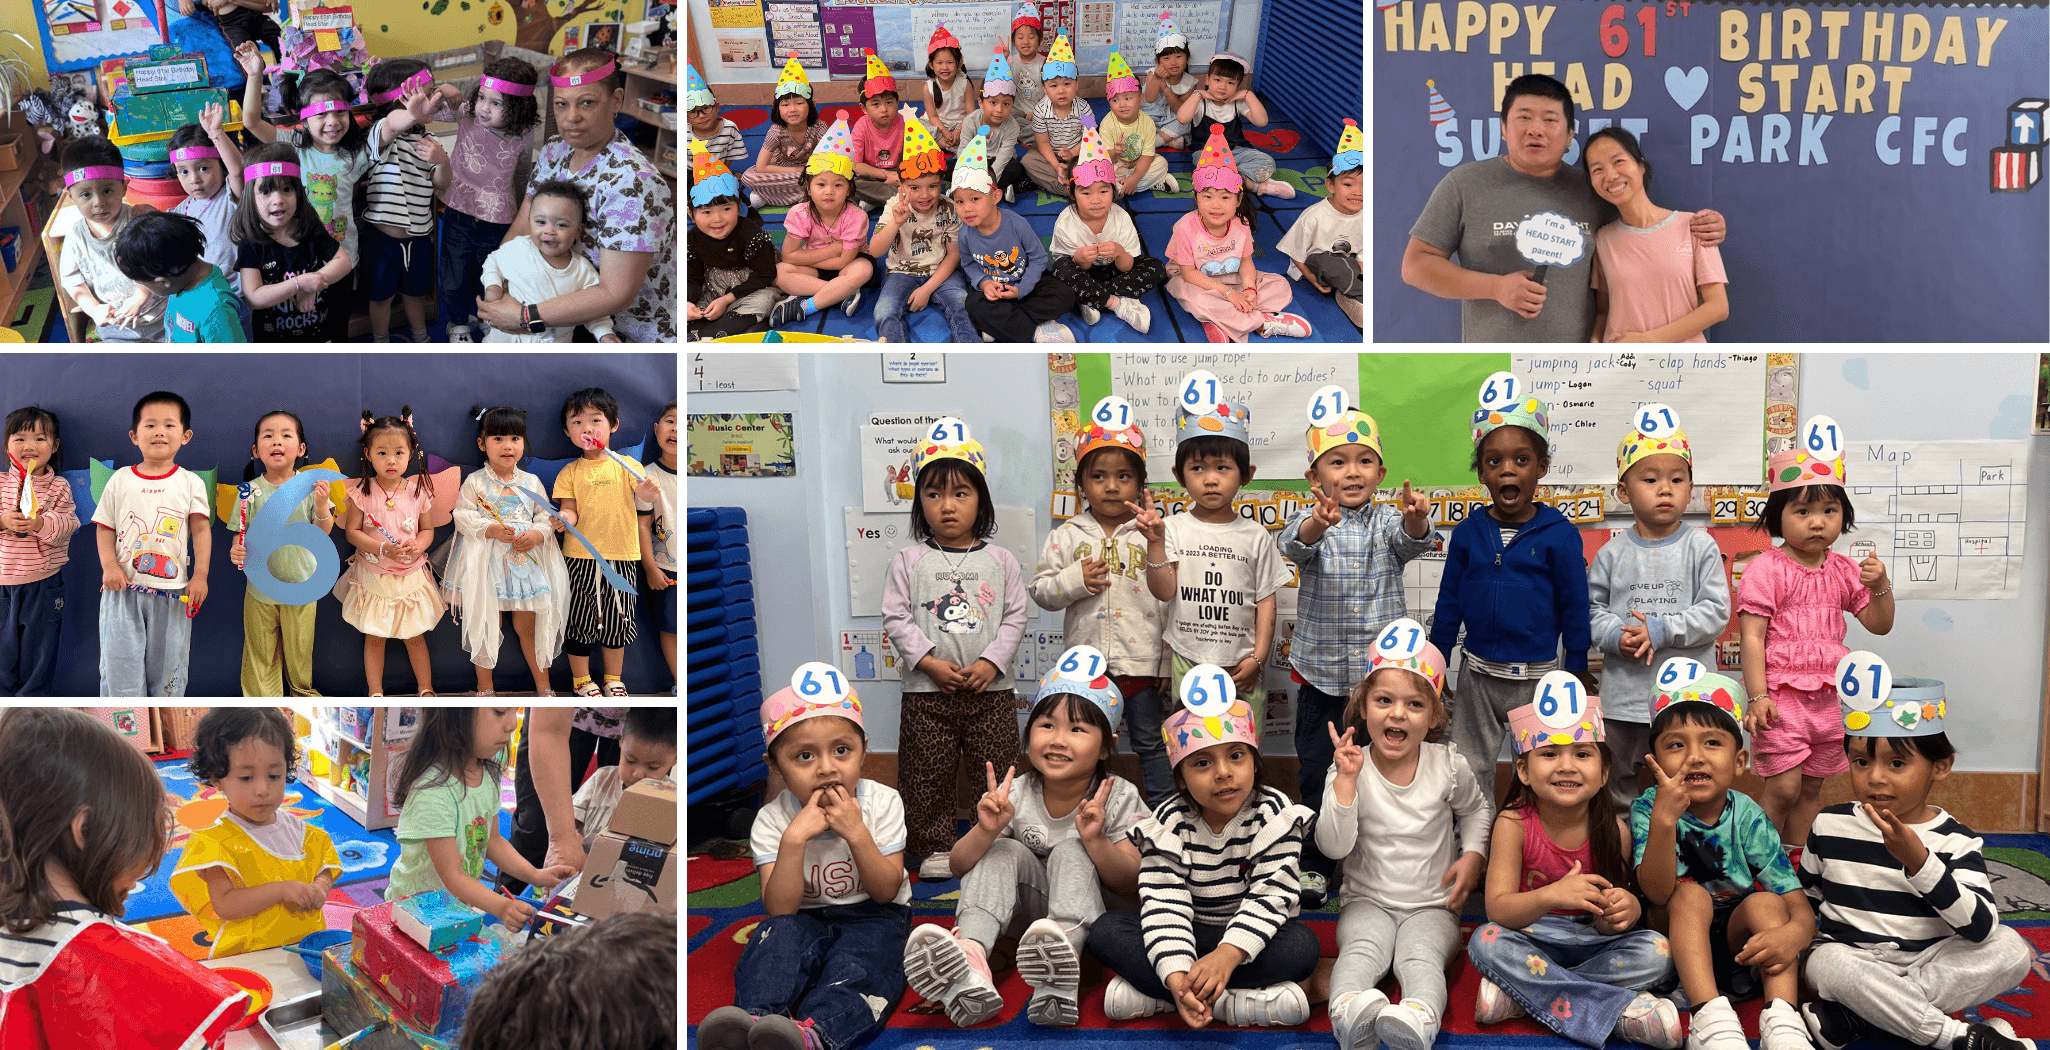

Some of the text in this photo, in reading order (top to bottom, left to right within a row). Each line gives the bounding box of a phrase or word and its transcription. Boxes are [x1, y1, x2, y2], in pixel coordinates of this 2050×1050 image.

[1383, 1, 1691, 58] HAPPY 61 ST
[1719, 8, 2009, 67] BIRTHDAY
[171, 66, 196, 74] Birthday
[1493, 61, 1912, 114] HAD START
[1690, 114, 1834, 166] PARK
[1875, 115, 1968, 167] CFC
[916, 153, 933, 171] 61
[953, 169, 968, 186] 61
[1205, 169, 1219, 182] 61
[1545, 219, 1558, 229] I'm
[1526, 229, 1549, 241] HEAD
[1551, 235, 1577, 248] START
[1532, 247, 1562, 260] parent!
[1125, 353, 1150, 364] How
[1155, 352, 1168, 364] to
[1171, 356, 1188, 364] use
[1192, 355, 1218, 367] jump
[1527, 354, 1615, 374] jumping jack
[1659, 353, 1727, 370] clap hands
[694, 366, 704, 378] 4
[1123, 367, 1336, 385] What do to our bodies?
[715, 380, 735, 389] least
[1183, 379, 1216, 405] 61
[1482, 378, 1514, 404] 61
[1529, 379, 1592, 394] jump Logan
[1647, 378, 1683, 391] squat
[1127, 392, 1171, 407] How to
[1311, 391, 1342, 420] 61
[1563, 400, 1595, 408] Osmarie
[871, 417, 912, 425] Question
[914, 416, 923, 424] of
[925, 416, 939, 424] the
[1096, 402, 1129, 425] 61
[1155, 415, 1168, 428] to
[1640, 408, 1674, 433] 61
[931, 423, 964, 441] 61
[1575, 420, 1596, 428] Chloe
[1153, 433, 1276, 448] to ame?
[1808, 424, 1838, 451] 61
[888, 446, 900, 454] ask
[1867, 444, 1912, 466] Map
[1981, 469, 2005, 481] Park
[1062, 496, 1067, 516] 1
[1172, 501, 1186, 517] 6
[1240, 503, 1254, 520] 9
[1449, 501, 1464, 521] 18
[1560, 501, 1577, 518] 23
[1578, 498, 1600, 517] 24
[1714, 500, 1737, 518] 29
[1745, 500, 1766, 518] 30
[1258, 506, 1277, 527] 10
[857, 528, 881, 539] Yes
[1199, 544, 1232, 556] LOADING
[1208, 552, 1236, 560] BETTER
[1237, 555, 1248, 564] LIFE
[936, 571, 979, 581] KUOMI
[1205, 570, 1222, 587] DO
[1181, 586, 1243, 606] WHAT YOU
[1199, 605, 1229, 621] LOVE
[843, 633, 849, 645] 1
[882, 632, 889, 643] 2
[1038, 632, 1046, 644] 6
[1380, 626, 1420, 653] 61
[1059, 651, 1100, 677] 61
[1660, 662, 1698, 685] 61
[1840, 662, 1882, 700] 61
[800, 669, 844, 696] 61
[1187, 674, 1228, 706] 61
[1538, 681, 1578, 717] 61
[629, 843, 664, 858] prime
